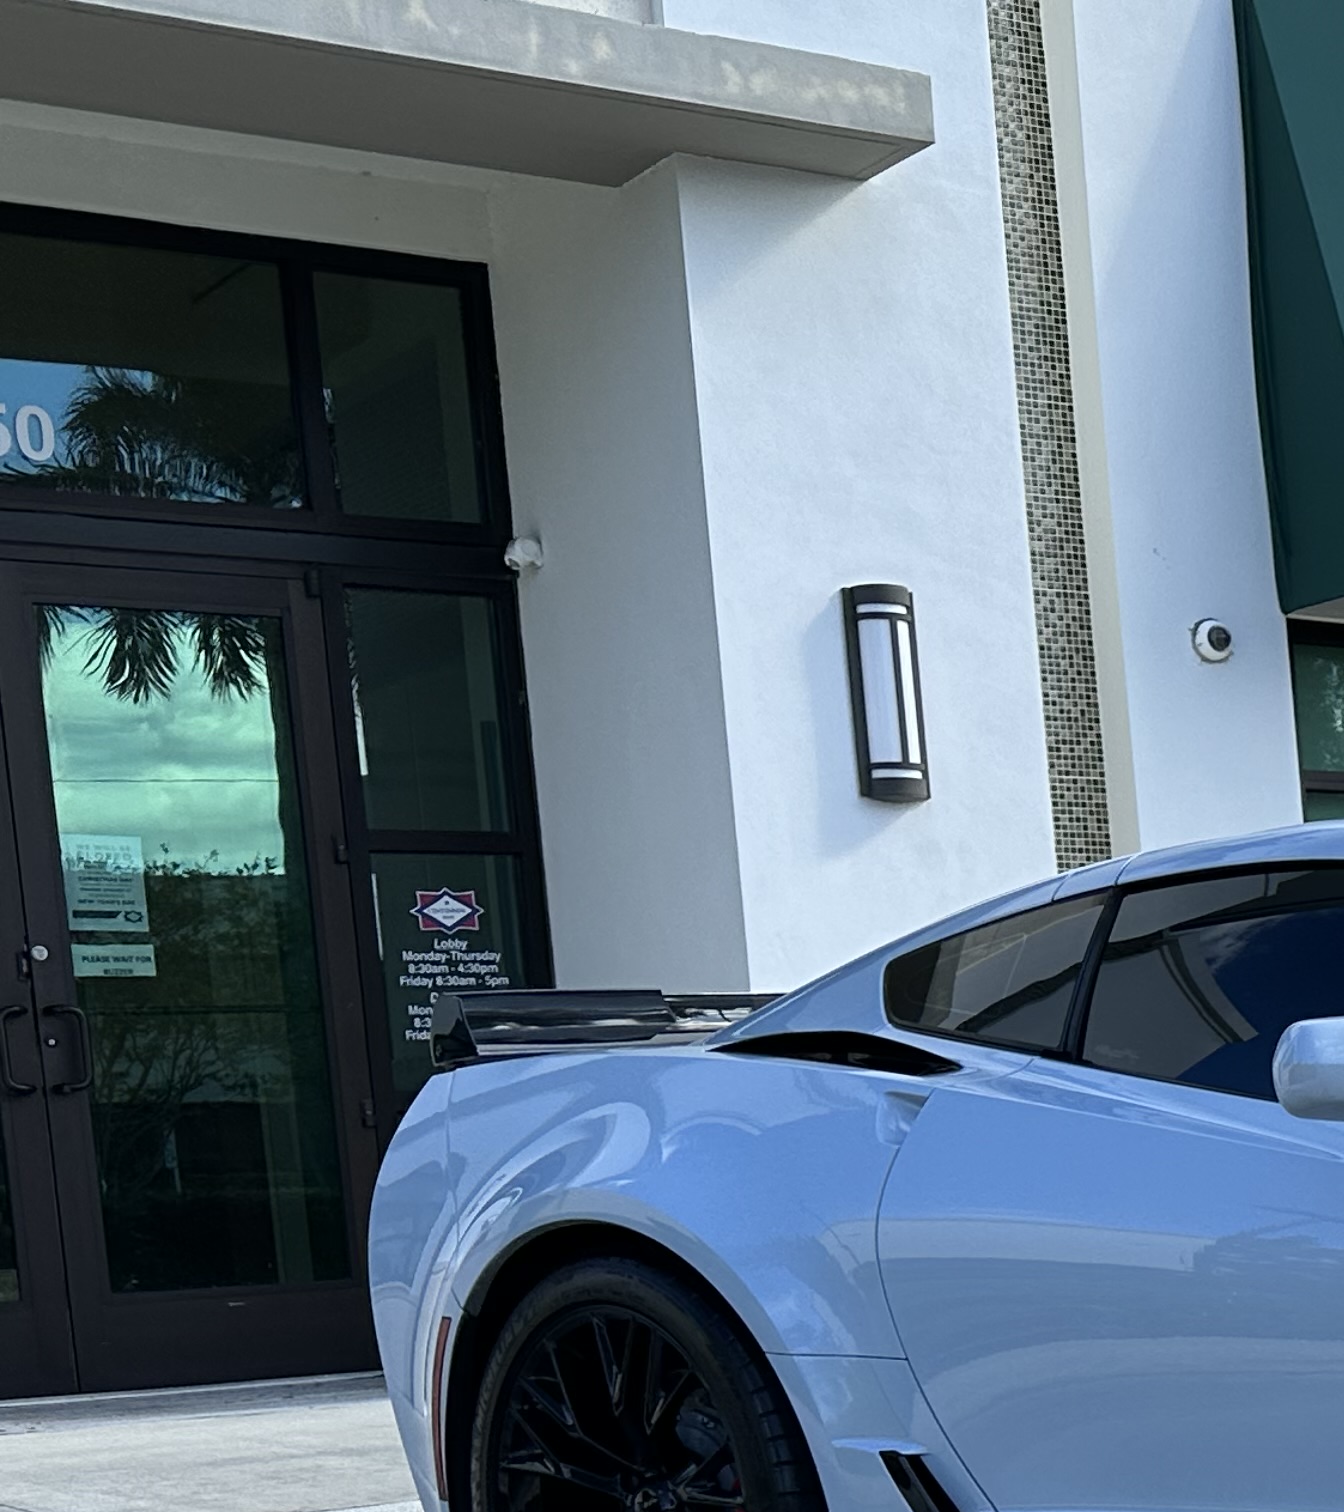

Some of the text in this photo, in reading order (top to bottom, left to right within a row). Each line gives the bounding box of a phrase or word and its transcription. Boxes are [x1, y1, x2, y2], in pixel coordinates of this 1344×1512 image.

[433, 937, 469, 951] Lobby
[81, 955, 111, 963] PLEASE
[402, 950, 502, 964] Monday-Thursday
[408, 963, 449, 974] 8:30am
[457, 963, 499, 975] 4:30pm
[399, 975, 434, 988] Friday
[435, 975, 477, 986] 8:30am
[484, 975, 509, 988] 5pm
[405, 1029, 432, 1041] Frida
